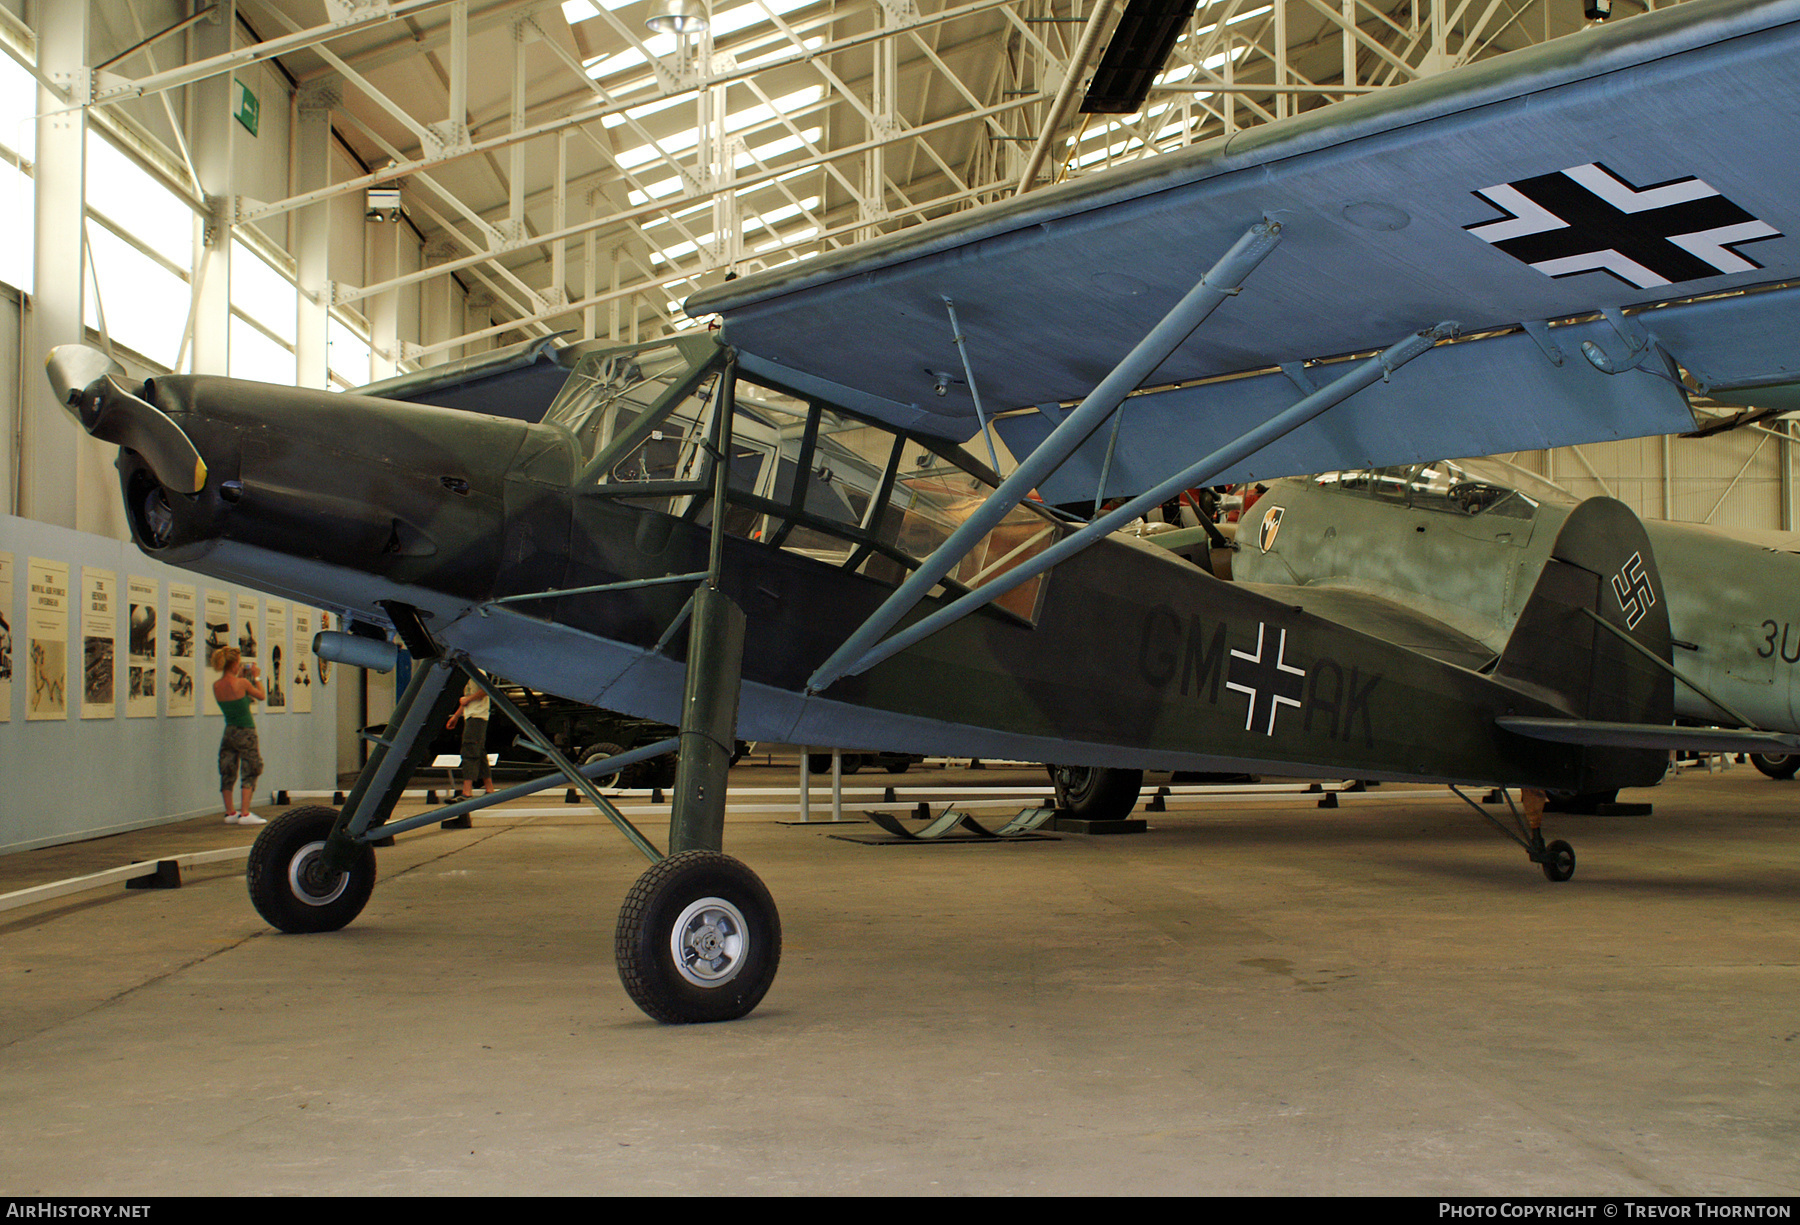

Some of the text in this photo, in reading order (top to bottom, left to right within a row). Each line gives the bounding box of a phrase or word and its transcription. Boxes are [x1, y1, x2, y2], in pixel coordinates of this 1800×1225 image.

[1138, 603, 1384, 749] GM AK
[1757, 619, 1800, 664] 3U
